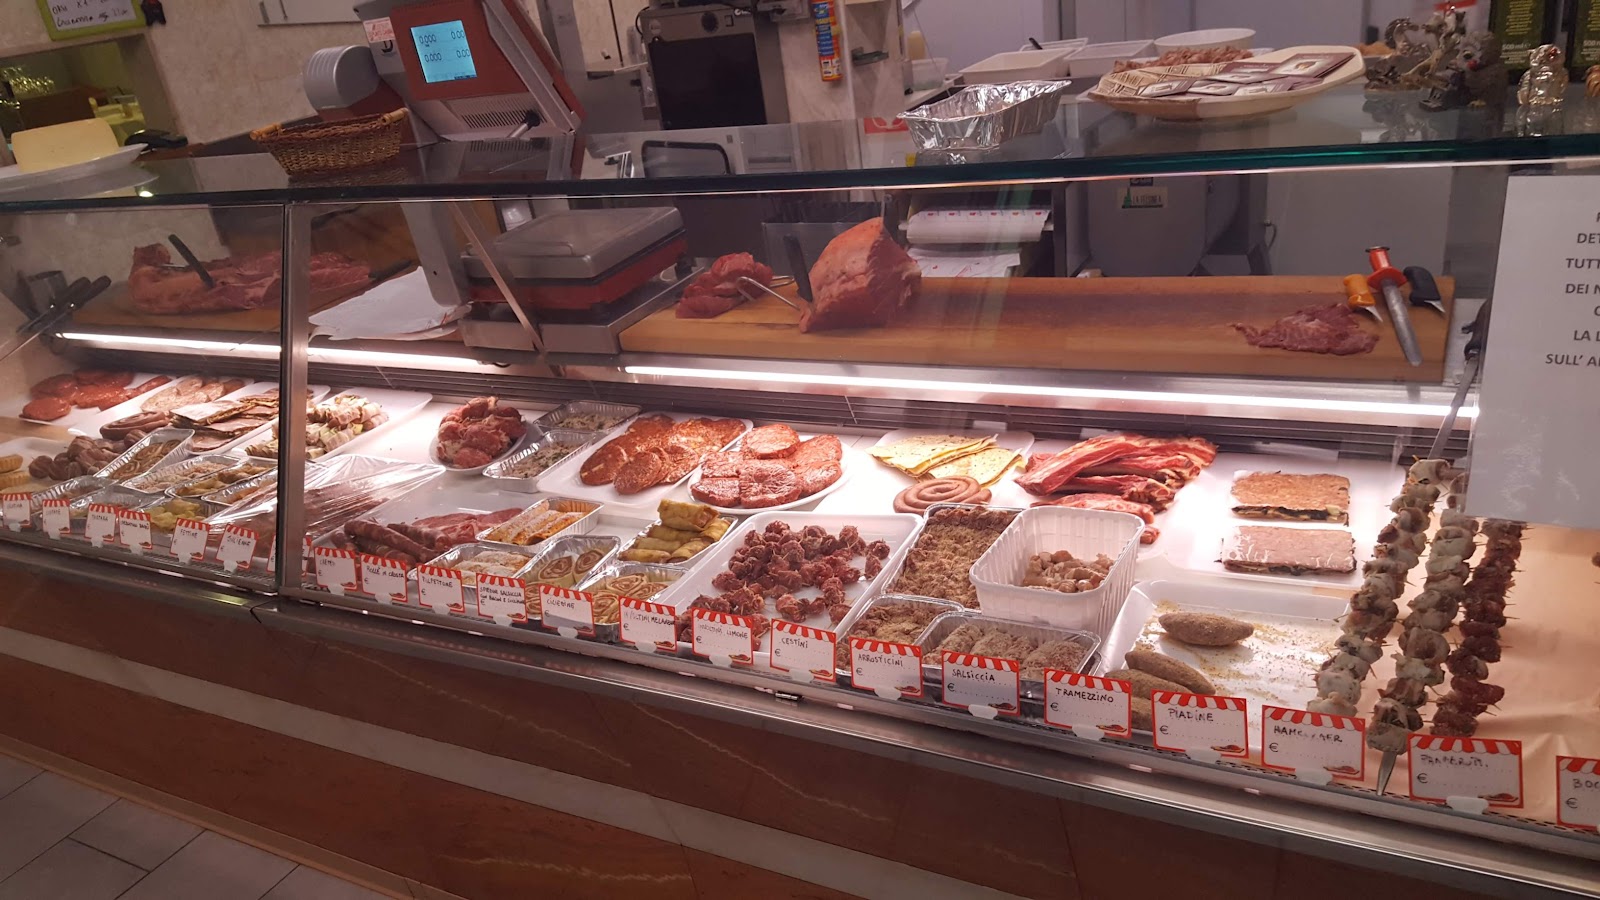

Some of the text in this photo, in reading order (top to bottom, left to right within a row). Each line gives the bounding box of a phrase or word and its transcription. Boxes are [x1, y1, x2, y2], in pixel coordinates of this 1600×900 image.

[1565, 283, 1589, 294] DEI
[1573, 330, 1591, 341] LA
[952, 668, 995, 682] SALSICCIA
[1055, 687, 1114, 703] TRAMEZZINO
[1168, 708, 1214, 722] PIADINE
